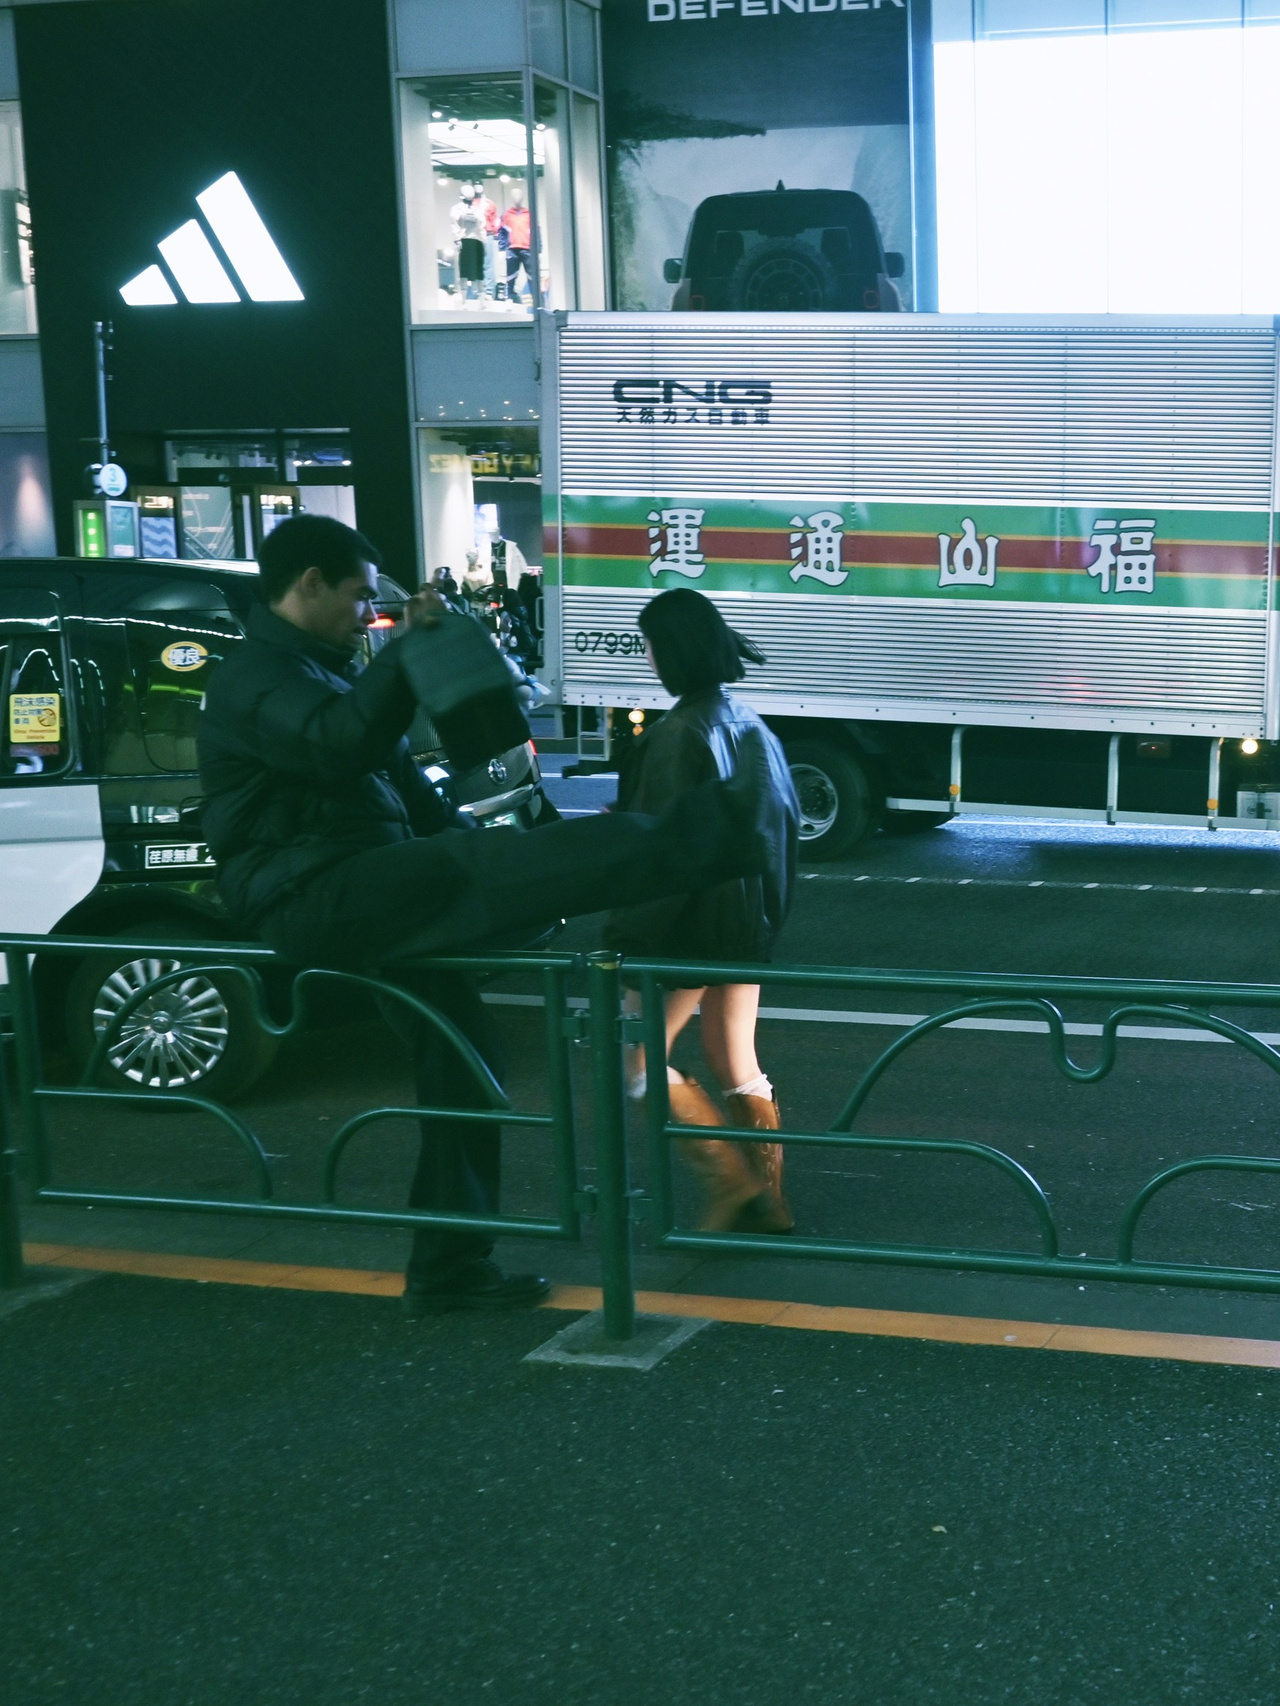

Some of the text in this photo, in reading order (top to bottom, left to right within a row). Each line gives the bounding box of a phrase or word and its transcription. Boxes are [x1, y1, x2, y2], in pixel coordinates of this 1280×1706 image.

[612, 380, 773, 405] CNG
[616, 406, 770, 425] 天然ガス自動車
